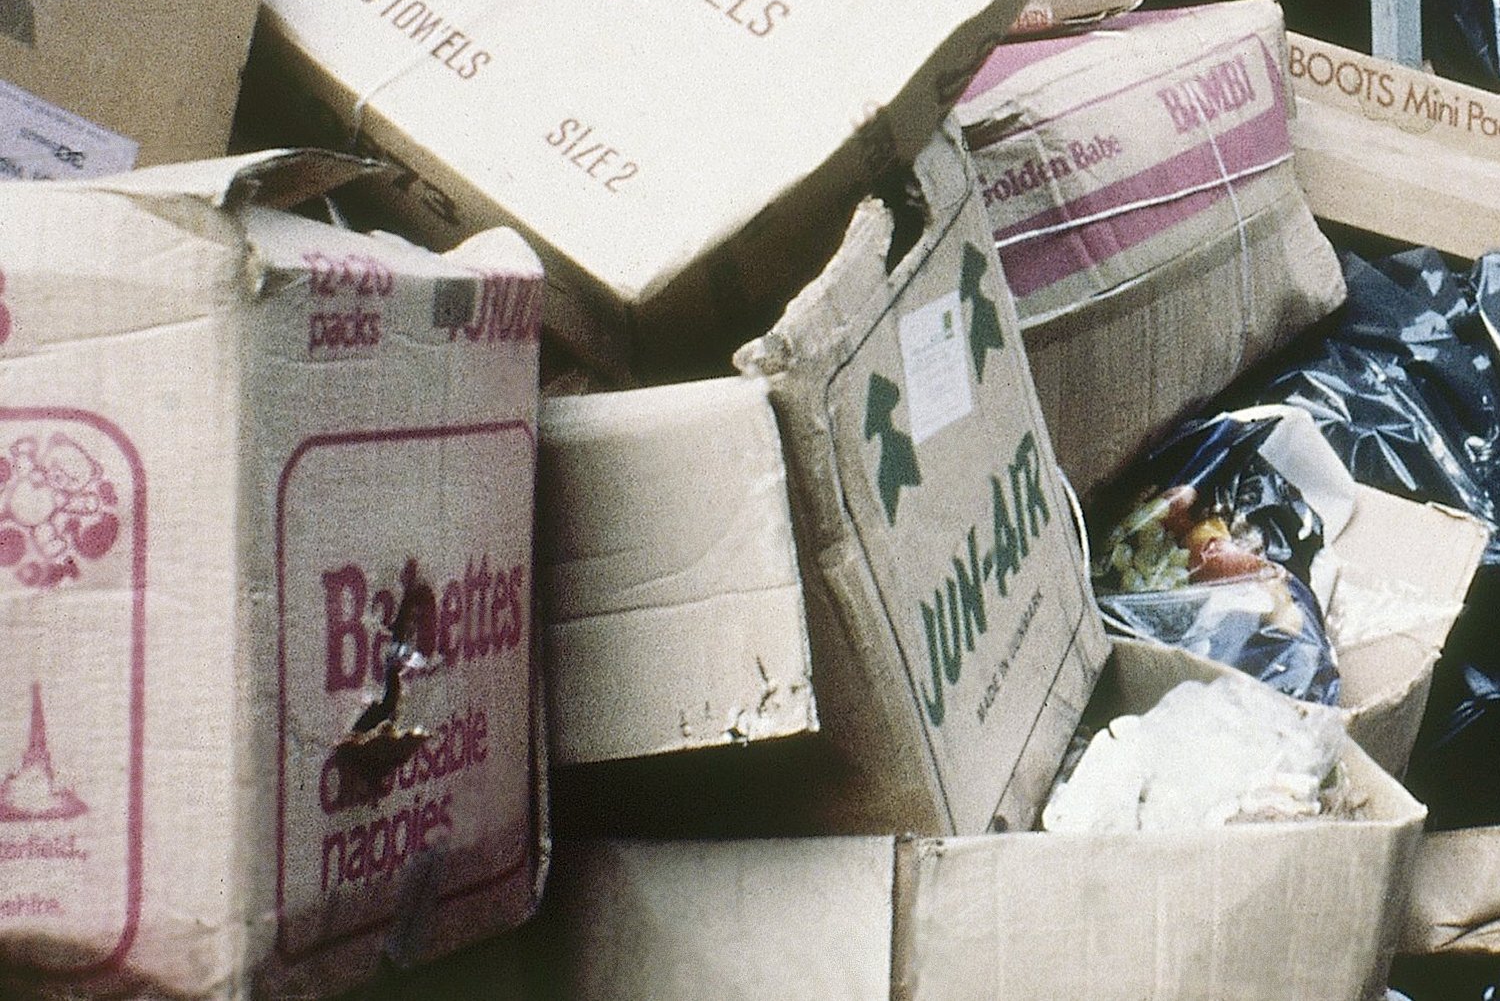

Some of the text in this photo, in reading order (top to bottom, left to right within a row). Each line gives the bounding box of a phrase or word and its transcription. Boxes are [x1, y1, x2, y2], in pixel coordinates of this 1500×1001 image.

[1157, 57, 1256, 137] BAMBI
[1288, 44, 1395, 109] BOOTS
[1403, 81, 1460, 128] Mini
[545, 117, 639, 194] SIZE 2
[1066, 134, 1122, 174] Babe
[308, 311, 381, 356] packs
[919, 429, 1051, 730] JUN-AIR
[320, 794, 456, 892] nappies
